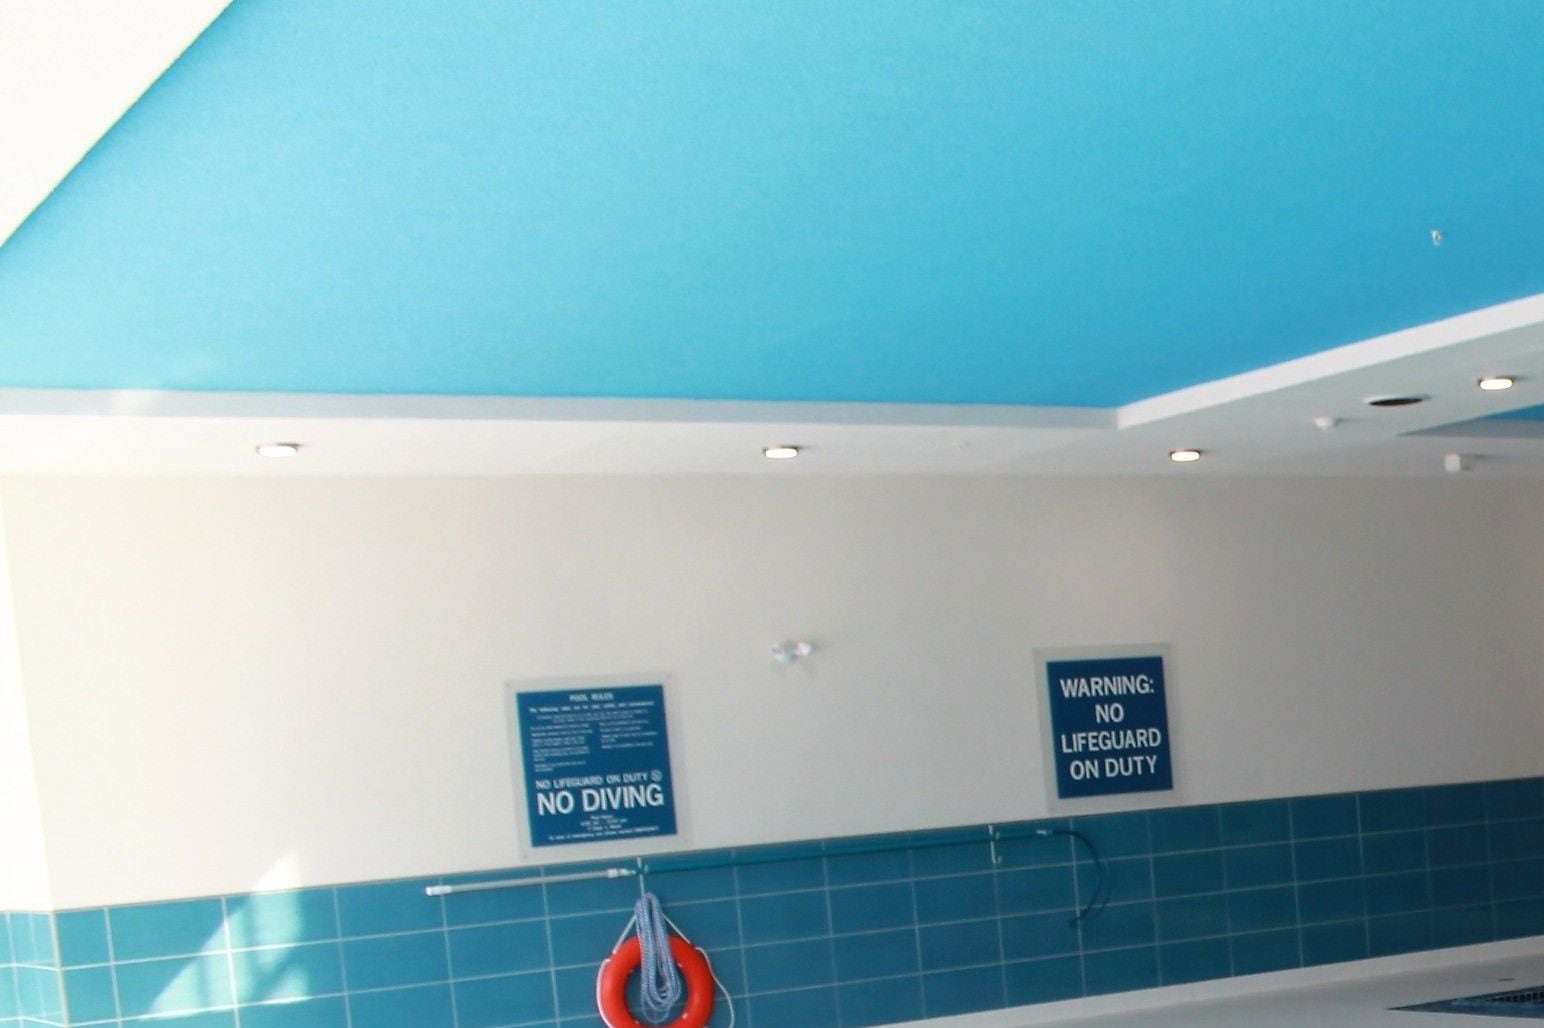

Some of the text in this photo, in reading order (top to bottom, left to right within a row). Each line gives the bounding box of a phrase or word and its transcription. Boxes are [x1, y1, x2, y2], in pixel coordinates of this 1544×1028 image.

[1060, 674, 1155, 699] WARNING:
[1095, 703, 1124, 724] NO
[1061, 728, 1161, 754] LIFEGUARD
[535, 771, 648, 790] NO LIFEGUARD ON DUTY
[1069, 755, 1157, 781] ON DUTY
[536, 783, 665, 816] NO DIVING
